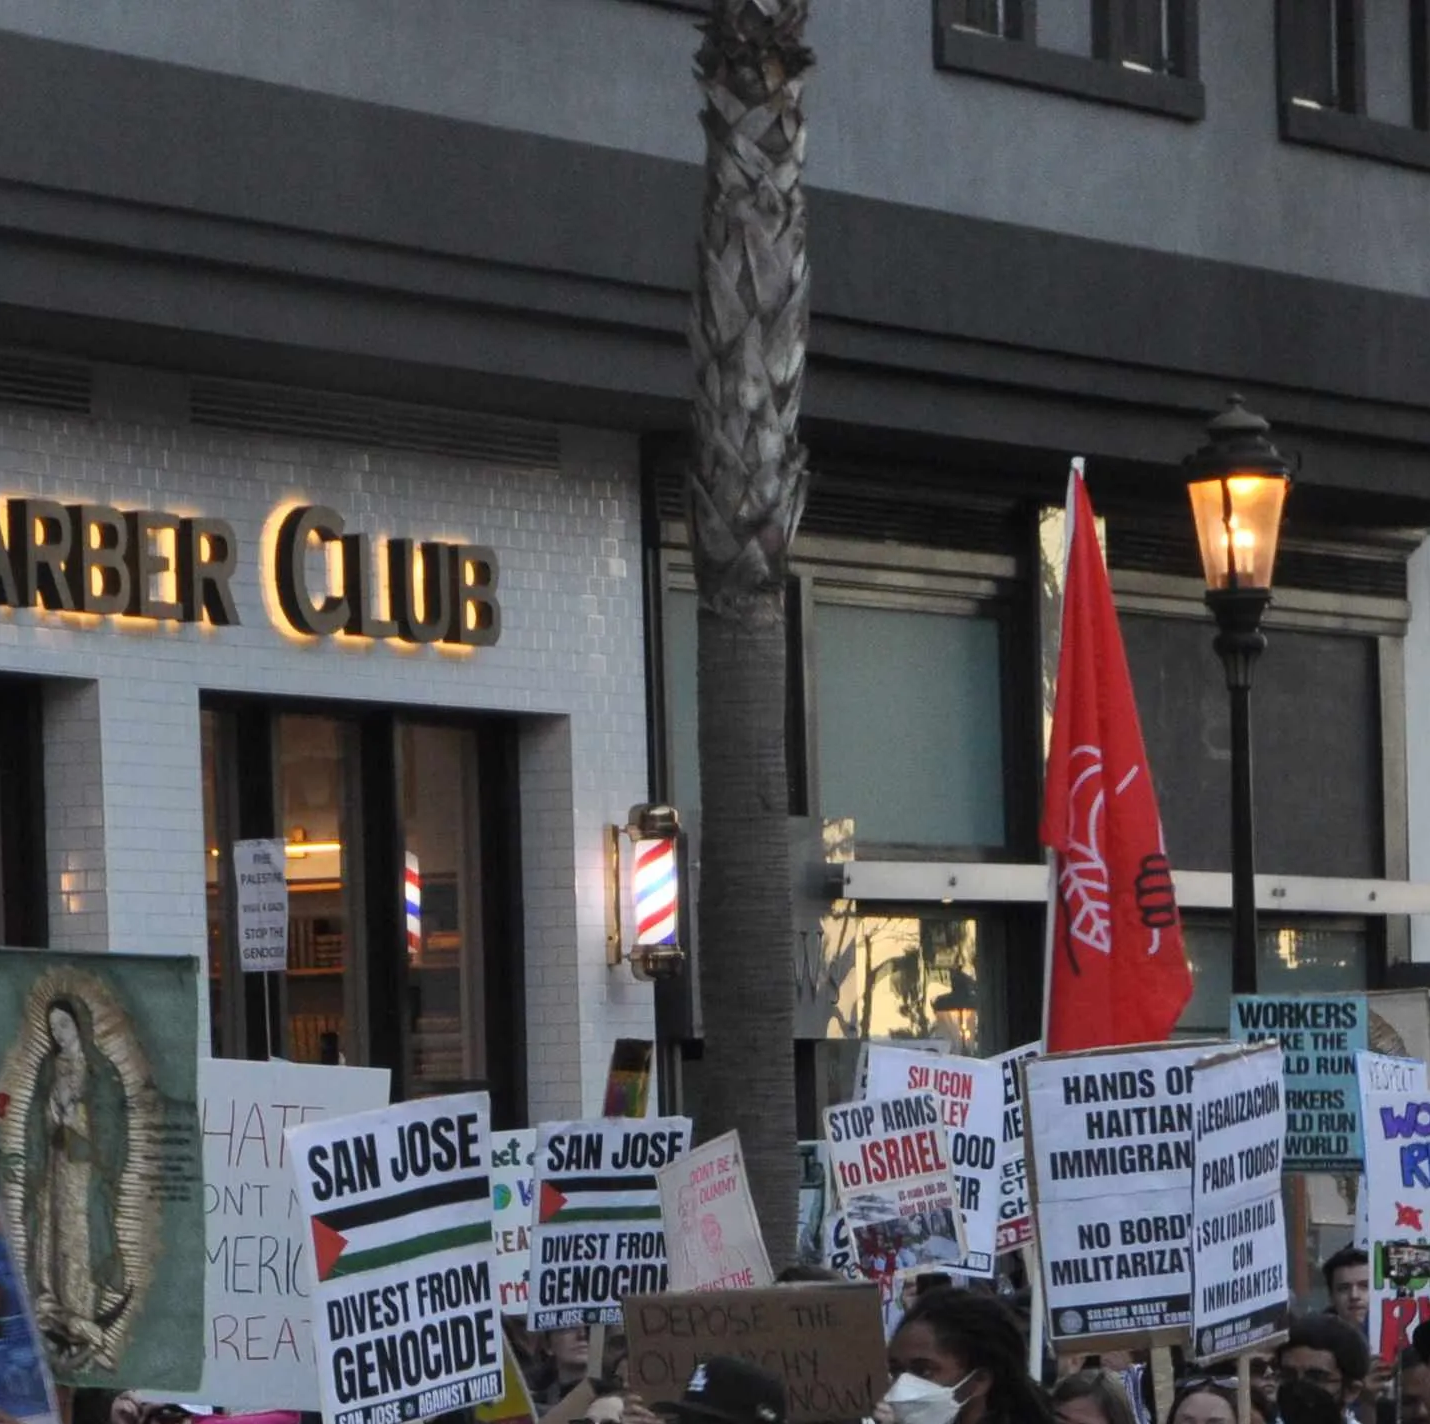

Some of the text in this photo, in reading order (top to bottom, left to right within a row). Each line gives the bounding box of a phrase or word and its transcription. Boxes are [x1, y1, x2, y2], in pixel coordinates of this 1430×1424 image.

[274, 504, 502, 648] CLUB
[1237, 1003, 1357, 1030] WORKERS
[1311, 1032, 1347, 1050] THE
[1316, 1057, 1355, 1075] RUN
[1062, 1069, 1156, 1105] HANDS
[829, 1093, 937, 1143] STOP ARMS
[1086, 1103, 1192, 1140] HAITIAN
[1196, 1079, 1280, 1141] ¡LEGALIZACIÓN
[1318, 1113, 1356, 1133] RUN
[307, 1133, 380, 1202] SAN
[390, 1113, 481, 1181] JOSE
[547, 1133, 603, 1171] SAN
[612, 1131, 683, 1170] JOSE
[838, 1130, 947, 1189] to ISRAEL
[1285, 1135, 1348, 1155] WORLD
[717, 1155, 730, 1173] BE
[1202, 1138, 1279, 1194] PARA TODOS!
[699, 1175, 738, 1205] DUMMY
[1078, 1222, 1111, 1250] NO
[1196, 1199, 1276, 1252] ¡SOLIDARIDAD
[541, 1233, 610, 1264] DIVEST
[1232, 1241, 1254, 1272] CON
[730, 1268, 756, 1289] THE
[1202, 1263, 1283, 1314] INMIGRANTES!
[326, 1260, 491, 1343] DIVEST FROM
[537, 1308, 584, 1329] SAN JOSE
[1130, 1301, 1168, 1316] VALLEY
[639, 1303, 842, 1337] DEPOSE THE
[332, 1309, 497, 1402] GENOCIDE
[418, 1386, 466, 1421] AGAINST
[469, 1373, 498, 1401] WAR
[789, 1375, 871, 1414] NOW!
